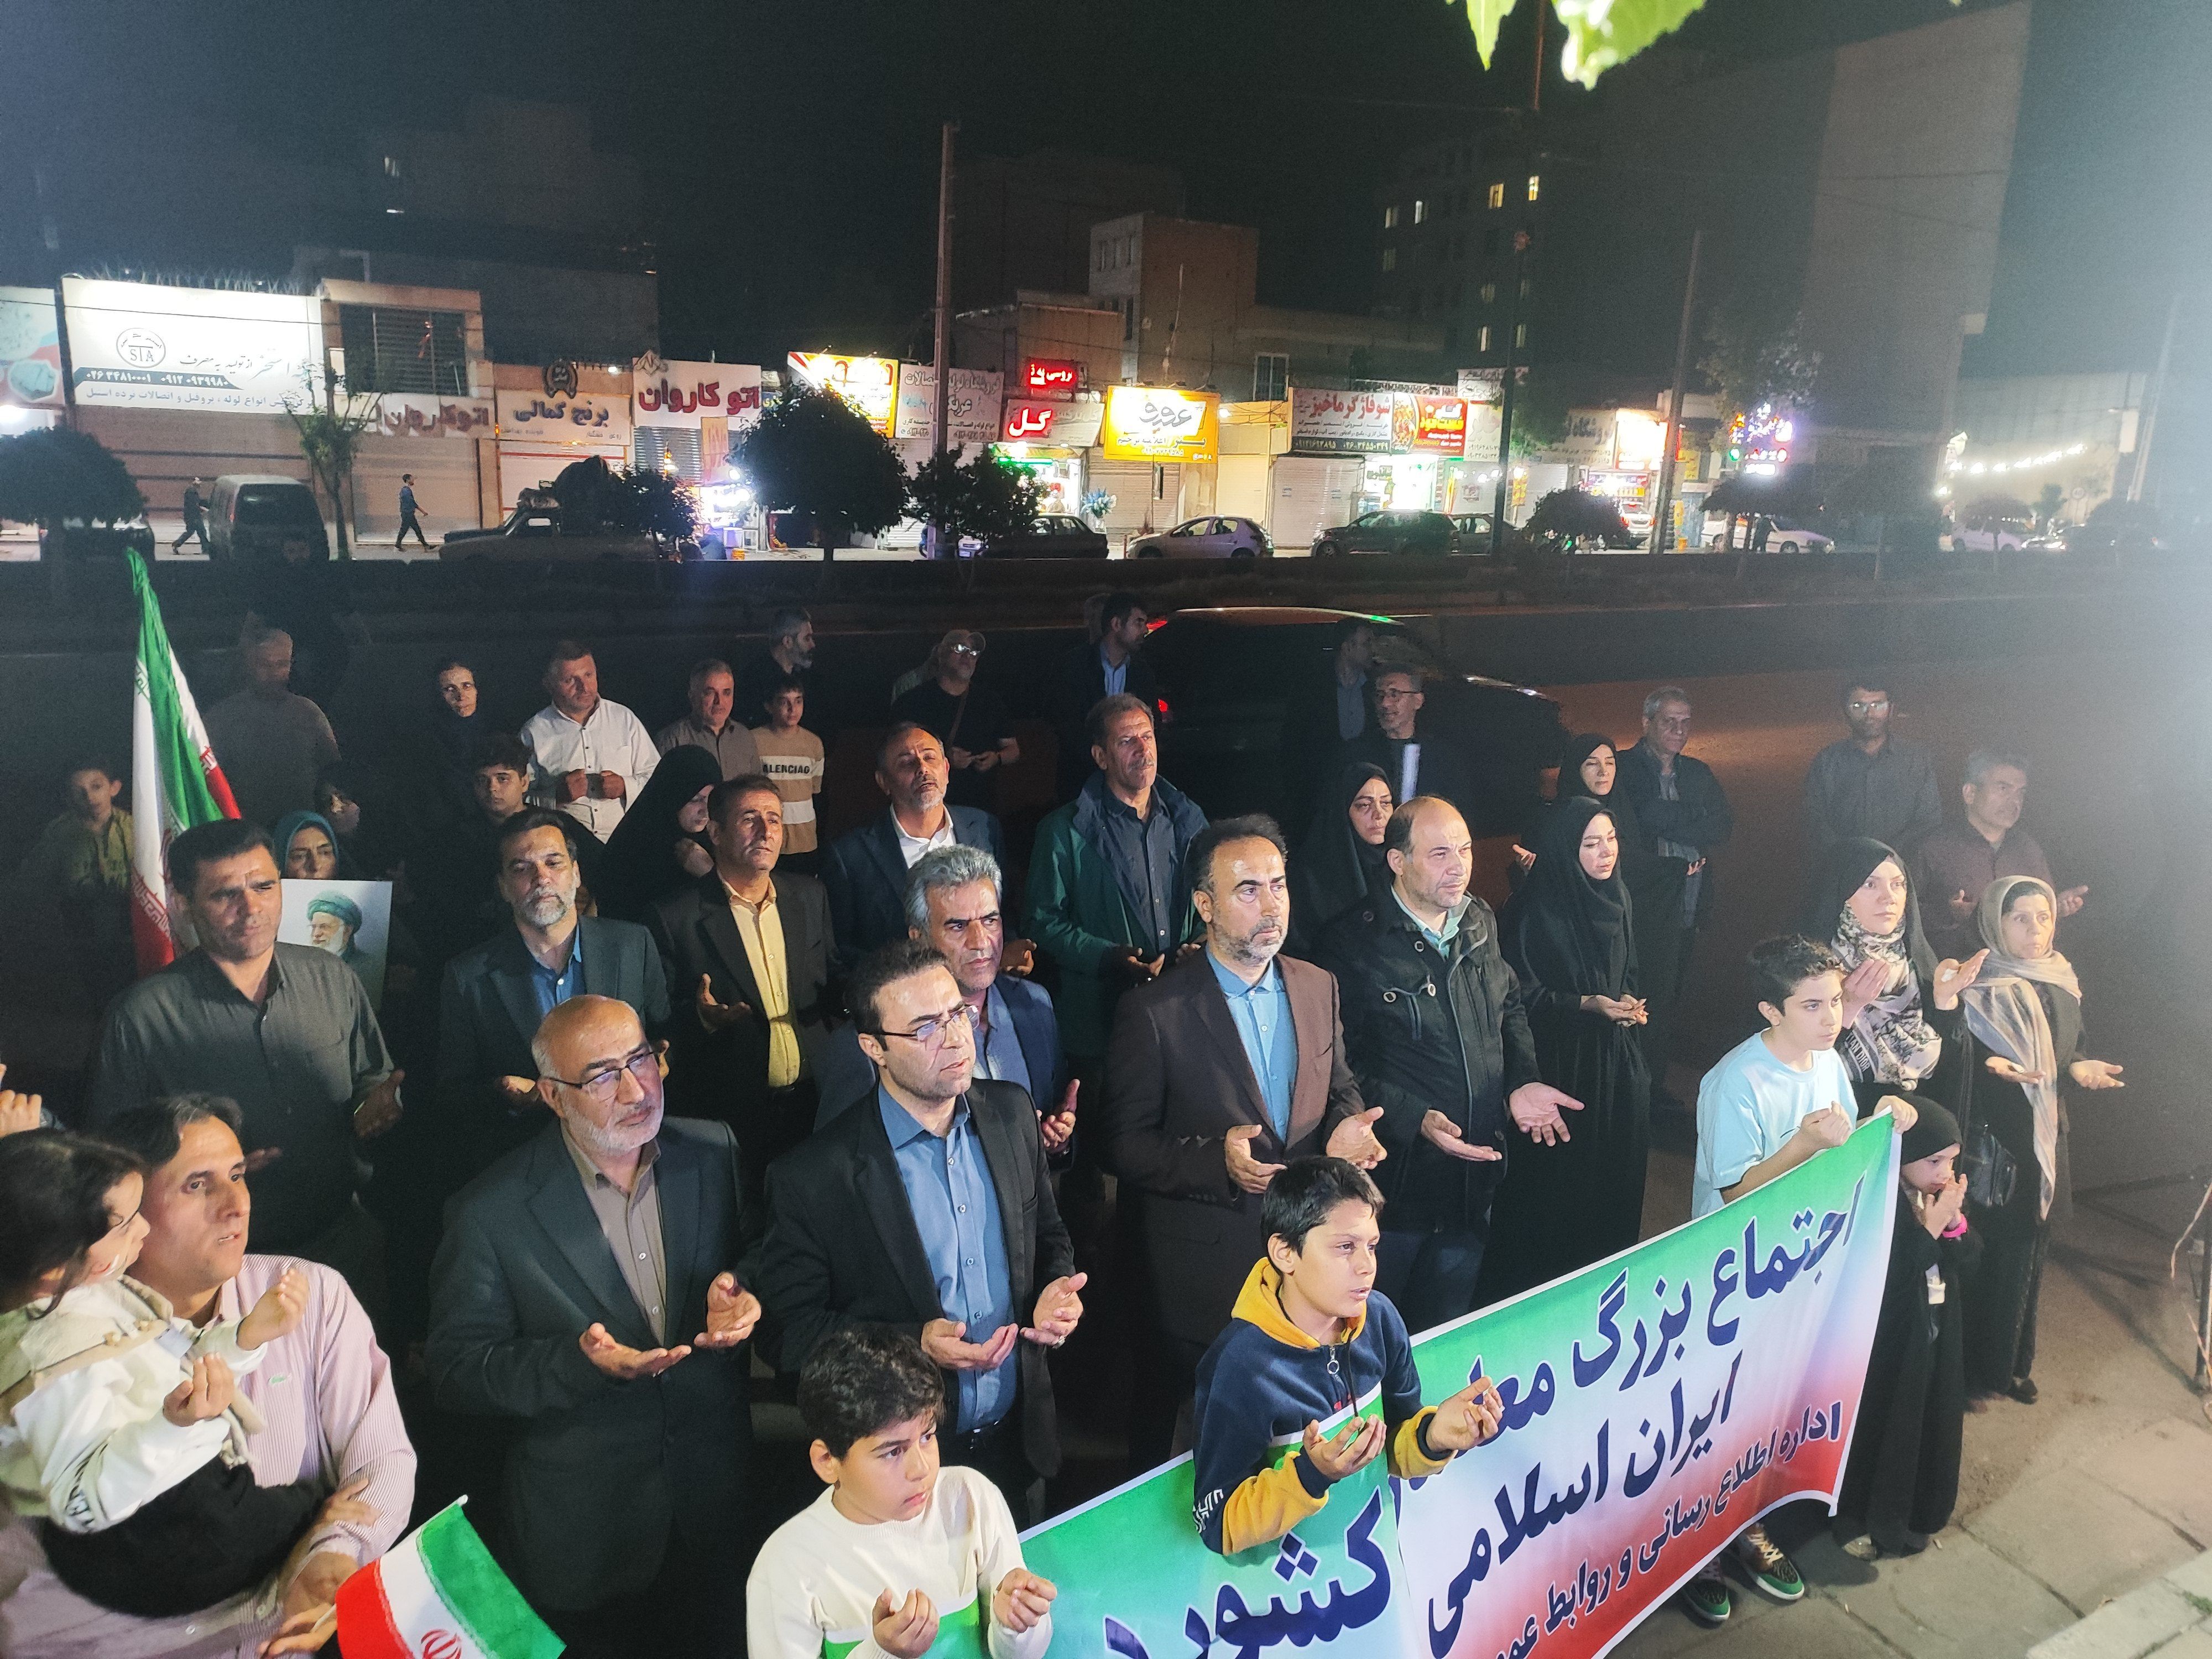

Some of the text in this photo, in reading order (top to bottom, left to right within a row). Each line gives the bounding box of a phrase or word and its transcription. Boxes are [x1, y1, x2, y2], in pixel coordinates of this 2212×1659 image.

[86, 371, 103, 380] ۰۲۶
[139, 390, 174, 400] اتصالات
[639, 379, 760, 415] اتو کاروان
[177, 395, 181, 403] و
[244, 397, 266, 406] انواع
[514, 399, 609, 428] برنج کمالی
[1009, 408, 1052, 437] گل
[1856, 1051, 1870, 1072] DIOR
[1708, 1172, 1865, 1345] اجتماع
[1573, 1267, 1691, 1391] بزرگ
[1779, 1402, 1841, 1462] اداره
[1715, 1431, 1776, 1514] اطلاع
[1428, 1350, 1742, 1658] ایران اسلامی
[1639, 1495, 1711, 1573] رسانی
[1185, 1486, 1391, 1659] کشور
[1617, 1546, 1633, 1590] و
[1546, 1558, 1611, 1635] روابط
